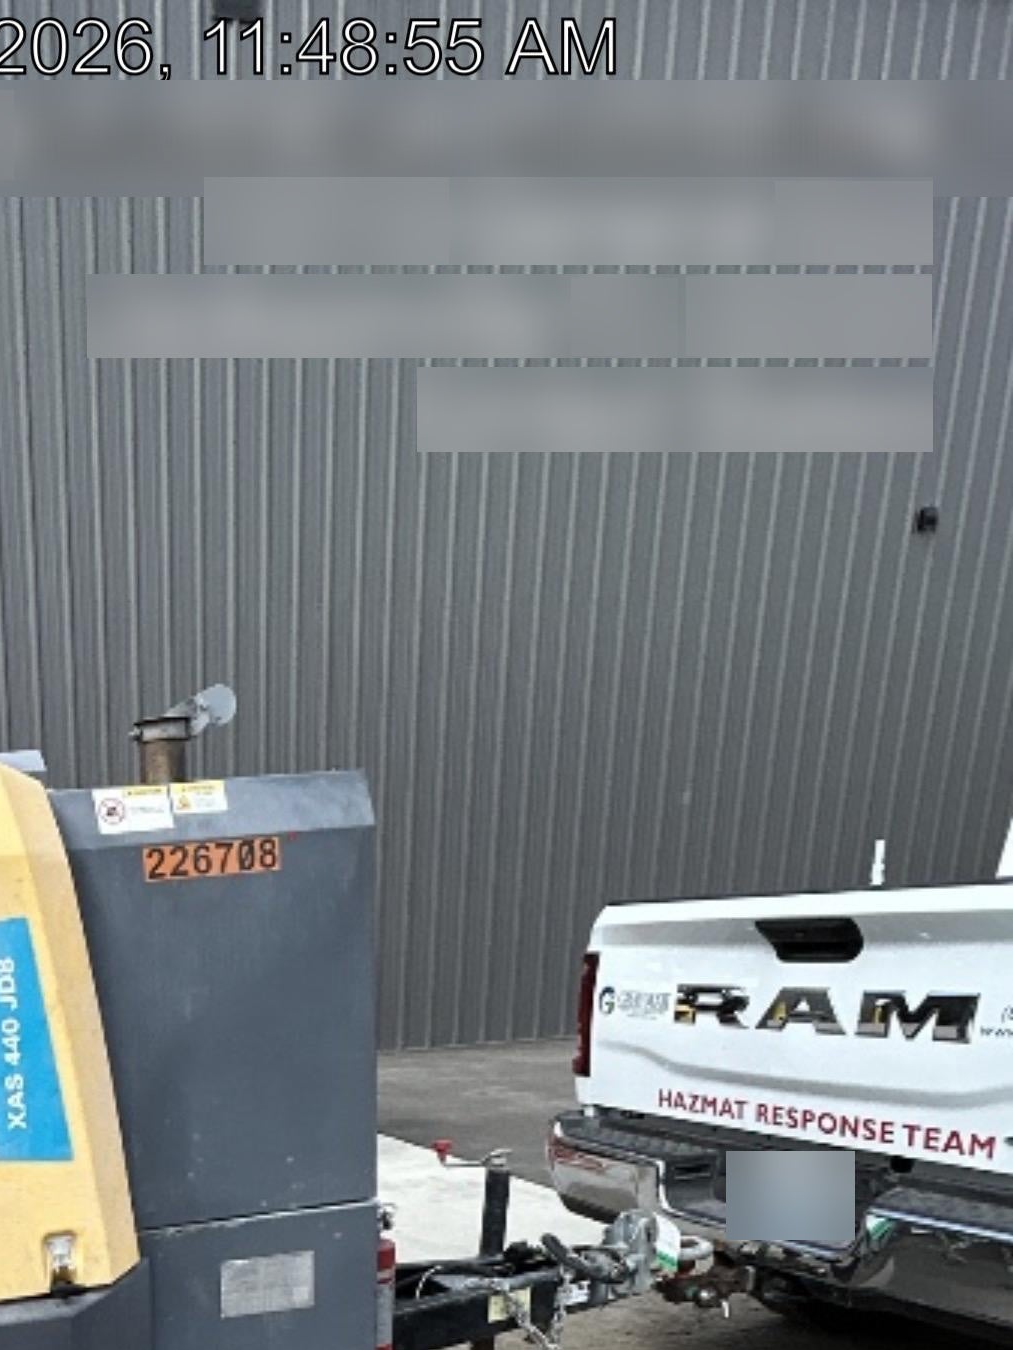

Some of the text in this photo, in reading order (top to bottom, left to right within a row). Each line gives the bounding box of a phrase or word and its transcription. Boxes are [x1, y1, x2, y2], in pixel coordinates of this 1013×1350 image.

[146, 839, 277, 879] 226708
[1, 1017, 22, 1066] 440
[673, 984, 981, 1044] RAM
[5, 1073, 27, 1130] XAS
[658, 1089, 996, 1160] HAZMAT RESPONSE TEAM
